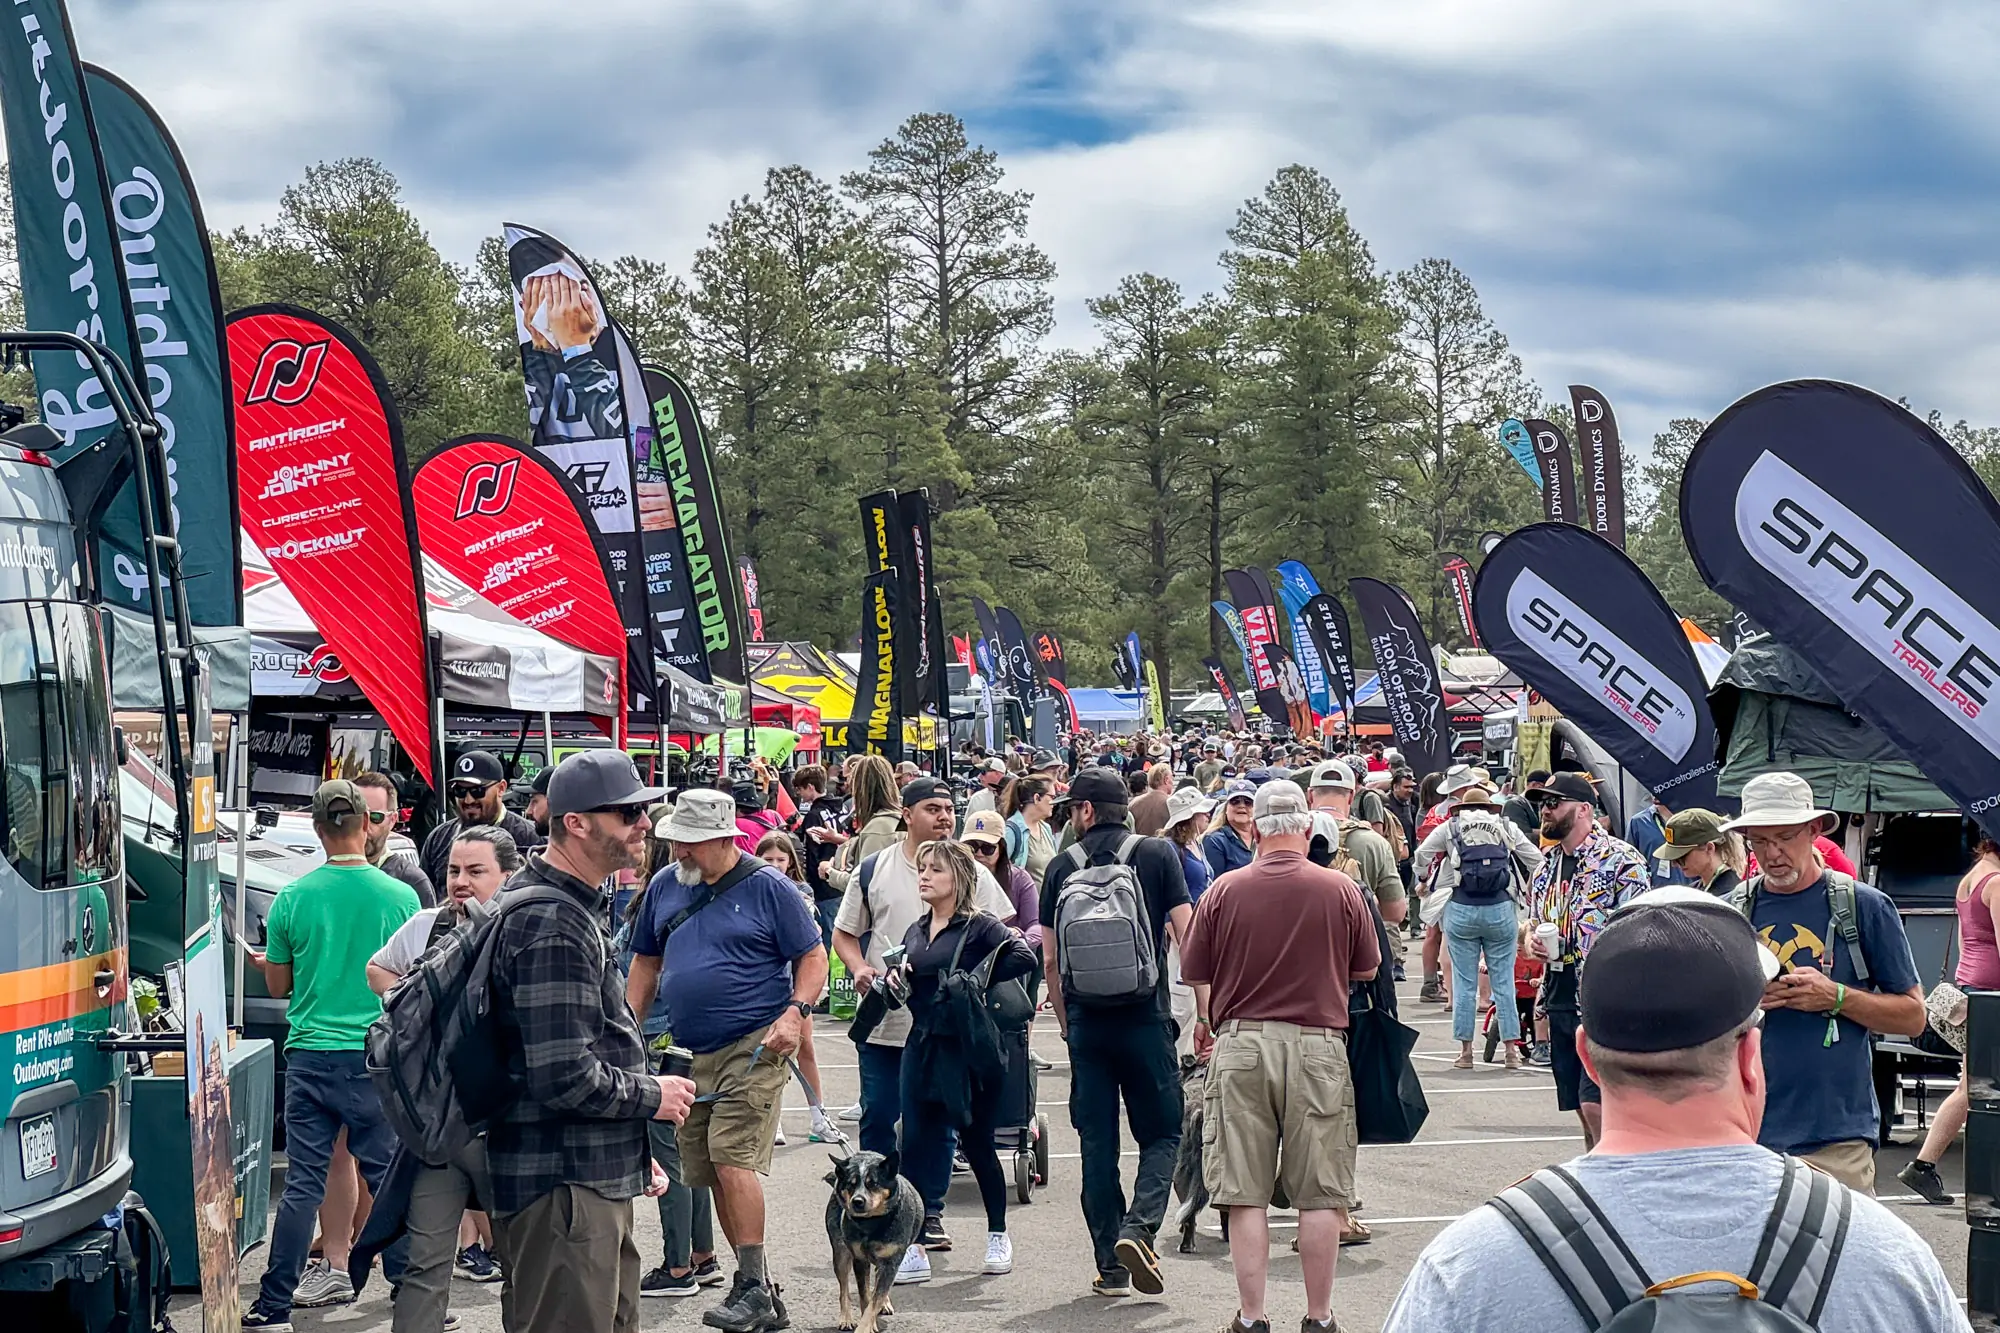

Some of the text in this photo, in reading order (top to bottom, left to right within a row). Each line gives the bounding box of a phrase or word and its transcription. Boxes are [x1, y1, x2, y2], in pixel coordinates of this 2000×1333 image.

[14, 0, 117, 447] utdoorsy
[267, 452, 352, 485] JOHNNY
[1548, 458, 1562, 516] DYNAMICS
[1591, 428, 1608, 532] DIODE DYNAMICS
[261, 497, 362, 528] CURRECTLYNC
[653, 392, 730, 655] ROCKAGATOR
[0, 533, 59, 586] utdoorsy
[265, 527, 366, 561] ROCKNUT
[484, 543, 554, 580] JOHNNY
[649, 552, 672, 561] GOOD
[499, 576, 569, 610] RRECTLYNC
[520, 600, 574, 627] CKNUT
[1452, 577, 1470, 636] BATTERIES
[1760, 497, 2000, 707] SPACE
[867, 586, 893, 740] MAGNAFLOW
[1318, 603, 1354, 691] TIRE TABLE
[1521, 597, 1675, 726] SPACE
[1370, 637, 1410, 744] BUILD YOUR ADVENTURE
[1379, 632, 1421, 741] ZION OFF-ROAD
[1891, 638, 1981, 720] TRAILERS
[1604, 685, 1658, 735] TRAILERS
[1653, 759, 1720, 794] spacetrailers.co
[15, 1022, 74, 1055] Rent RVs online
[12, 1054, 74, 1085] Outdoorsy.com
